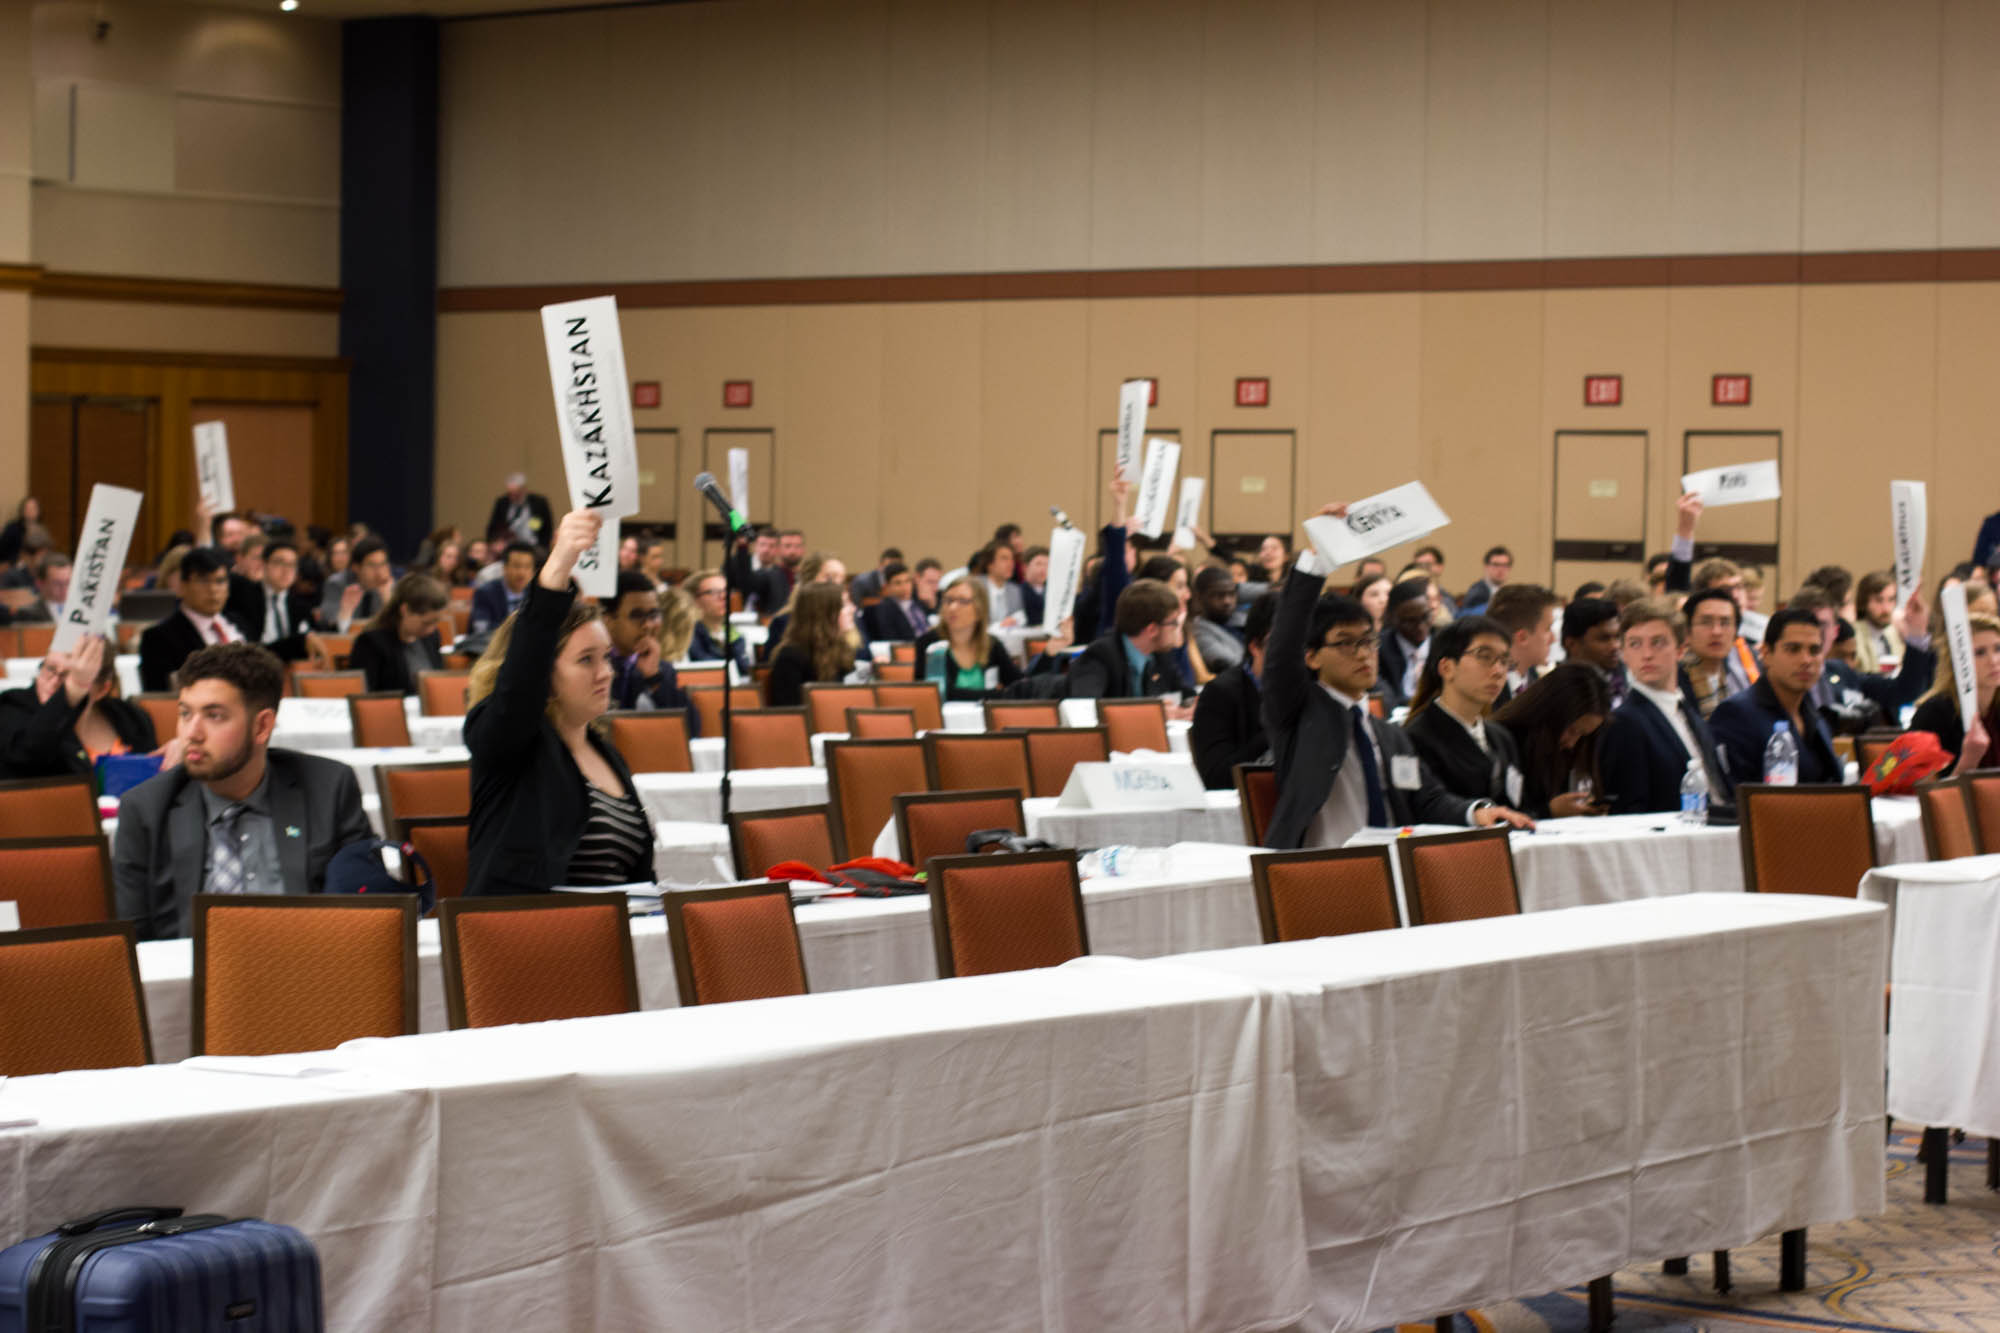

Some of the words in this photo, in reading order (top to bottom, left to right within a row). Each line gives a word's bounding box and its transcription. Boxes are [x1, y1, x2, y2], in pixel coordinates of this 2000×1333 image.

[565, 316, 614, 508] KAZAKHSTAN
[1591, 379, 1618, 402] EXIT
[1718, 379, 1746, 402] EXIT
[69, 518, 116, 626] PAKISTAN
